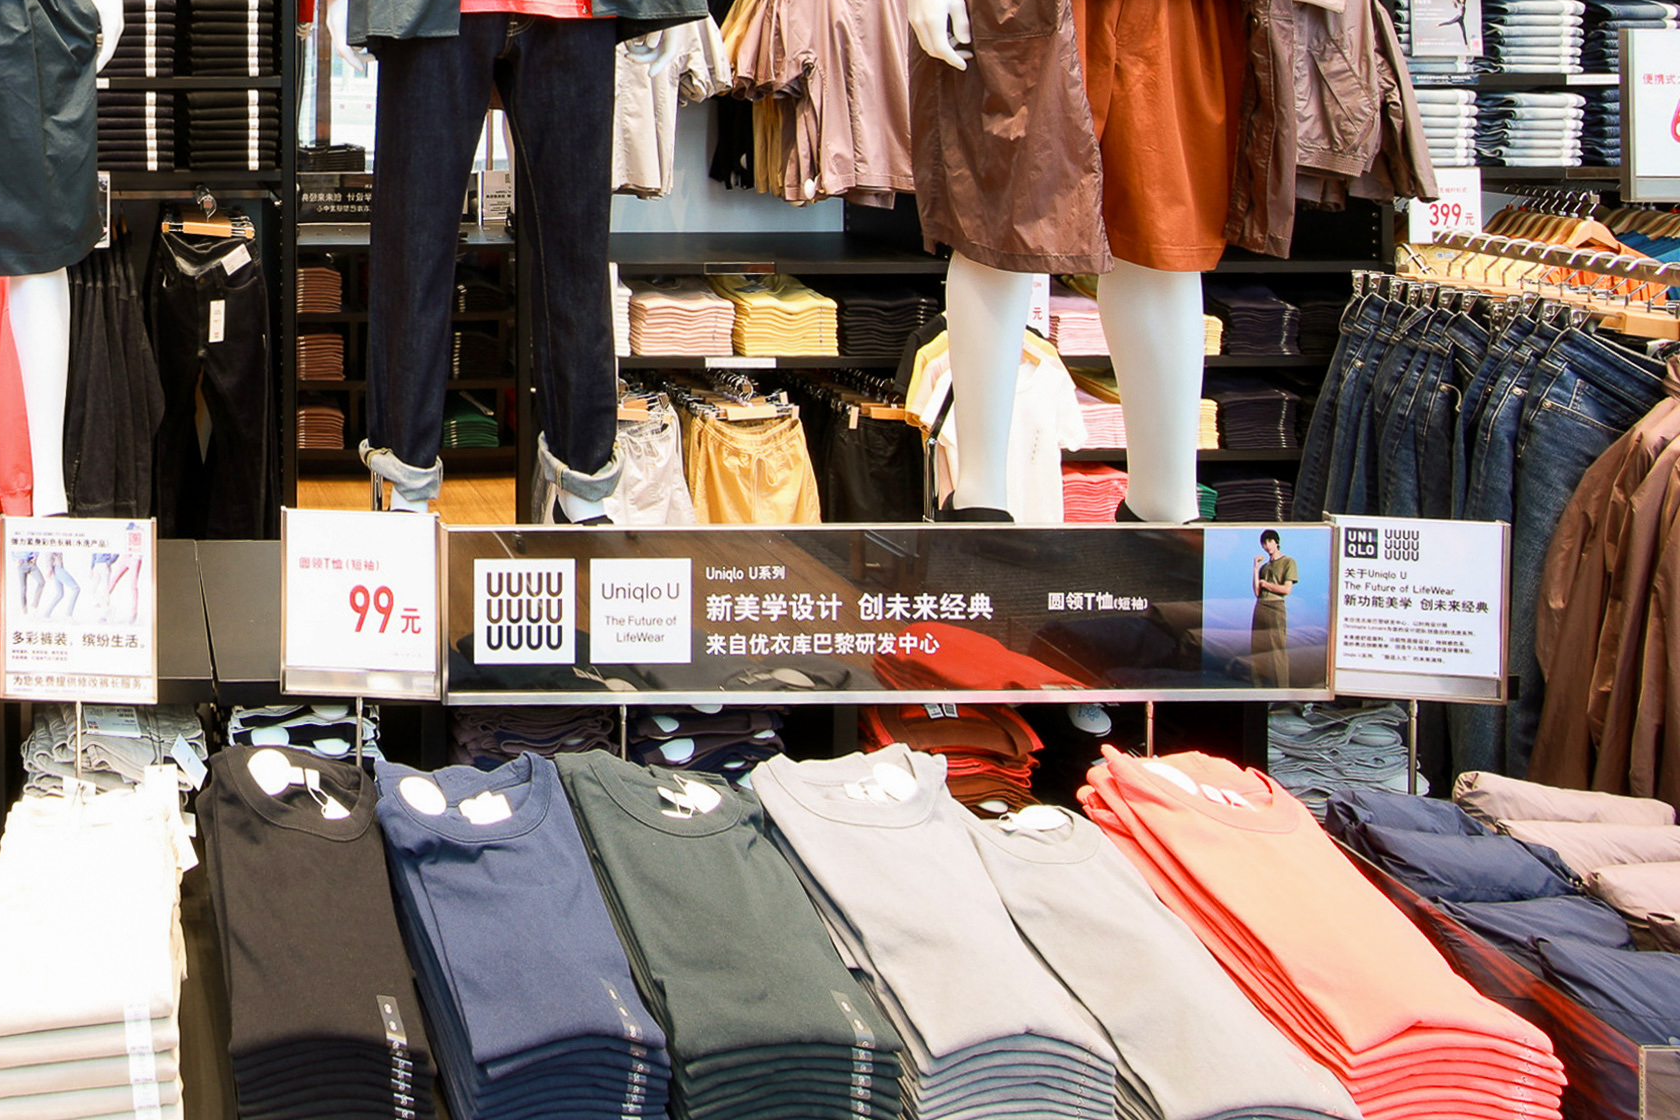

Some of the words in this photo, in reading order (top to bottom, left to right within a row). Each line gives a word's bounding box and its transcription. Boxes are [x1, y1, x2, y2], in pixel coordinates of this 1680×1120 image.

[1347, 530, 1373, 542] UNI
[1347, 543, 1375, 556] QLO
[705, 566, 744, 583] Uniqlo
[749, 566, 786, 580] U系列
[1400, 571, 1407, 580] U
[601, 582, 662, 602] Uniqlo
[666, 583, 680, 599] U
[1344, 581, 1361, 591] The
[1365, 583, 1396, 593] Future
[1400, 584, 1409, 593] of
[1413, 584, 1455, 595] LifeWear
[706, 592, 842, 622] 新美学设计
[858, 592, 993, 621] 创未来经典
[1343, 594, 1412, 610] 新功能美学
[1420, 598, 1489, 614] 创未来经典
[605, 615, 624, 626] The
[627, 615, 662, 626] Future
[665, 615, 677, 626] of
[616, 632, 665, 643] LifeWear
[706, 633, 940, 656] 来自优衣库巴黎研发中心
